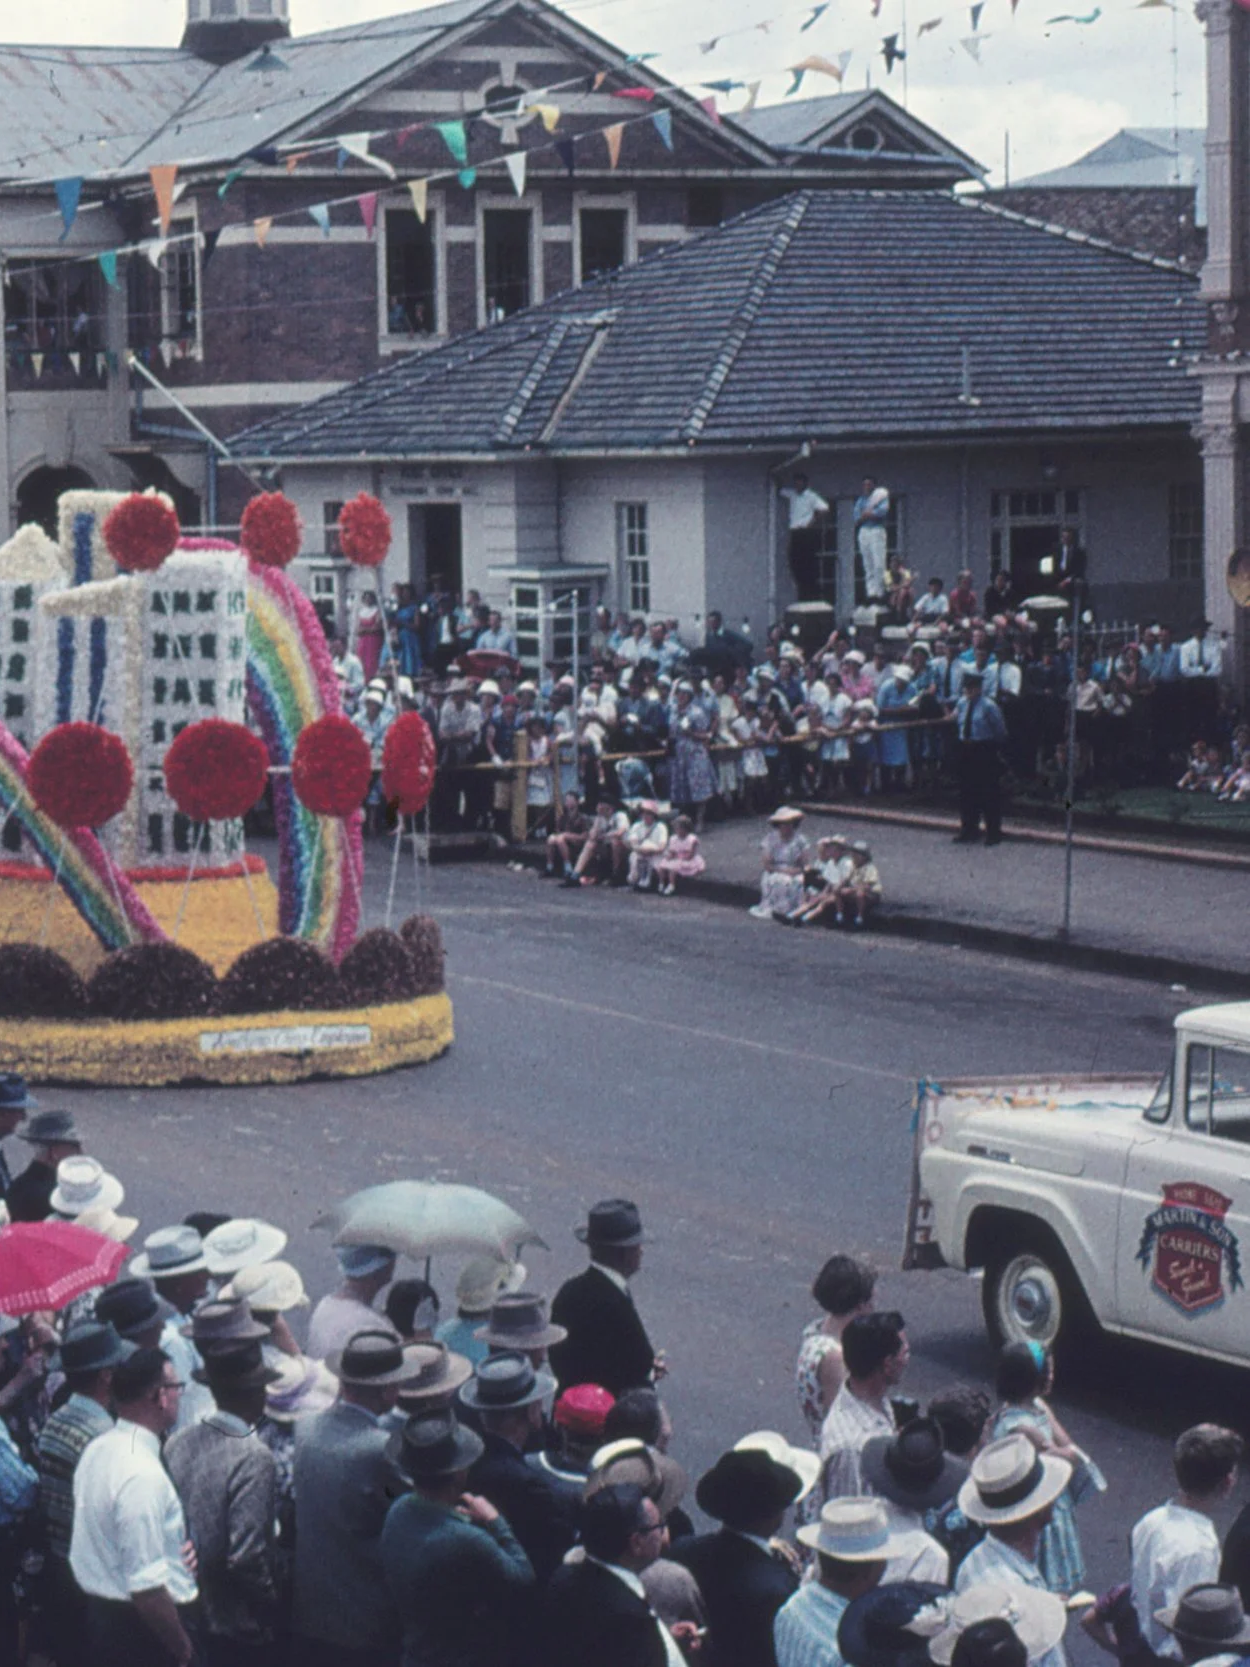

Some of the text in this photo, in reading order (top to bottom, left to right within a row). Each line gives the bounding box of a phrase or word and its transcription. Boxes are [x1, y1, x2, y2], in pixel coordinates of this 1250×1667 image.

[1153, 1207, 1198, 1227] MARTIN
[1210, 1219, 1231, 1248] SON
[1160, 1234, 1219, 1261] CARRIERS
